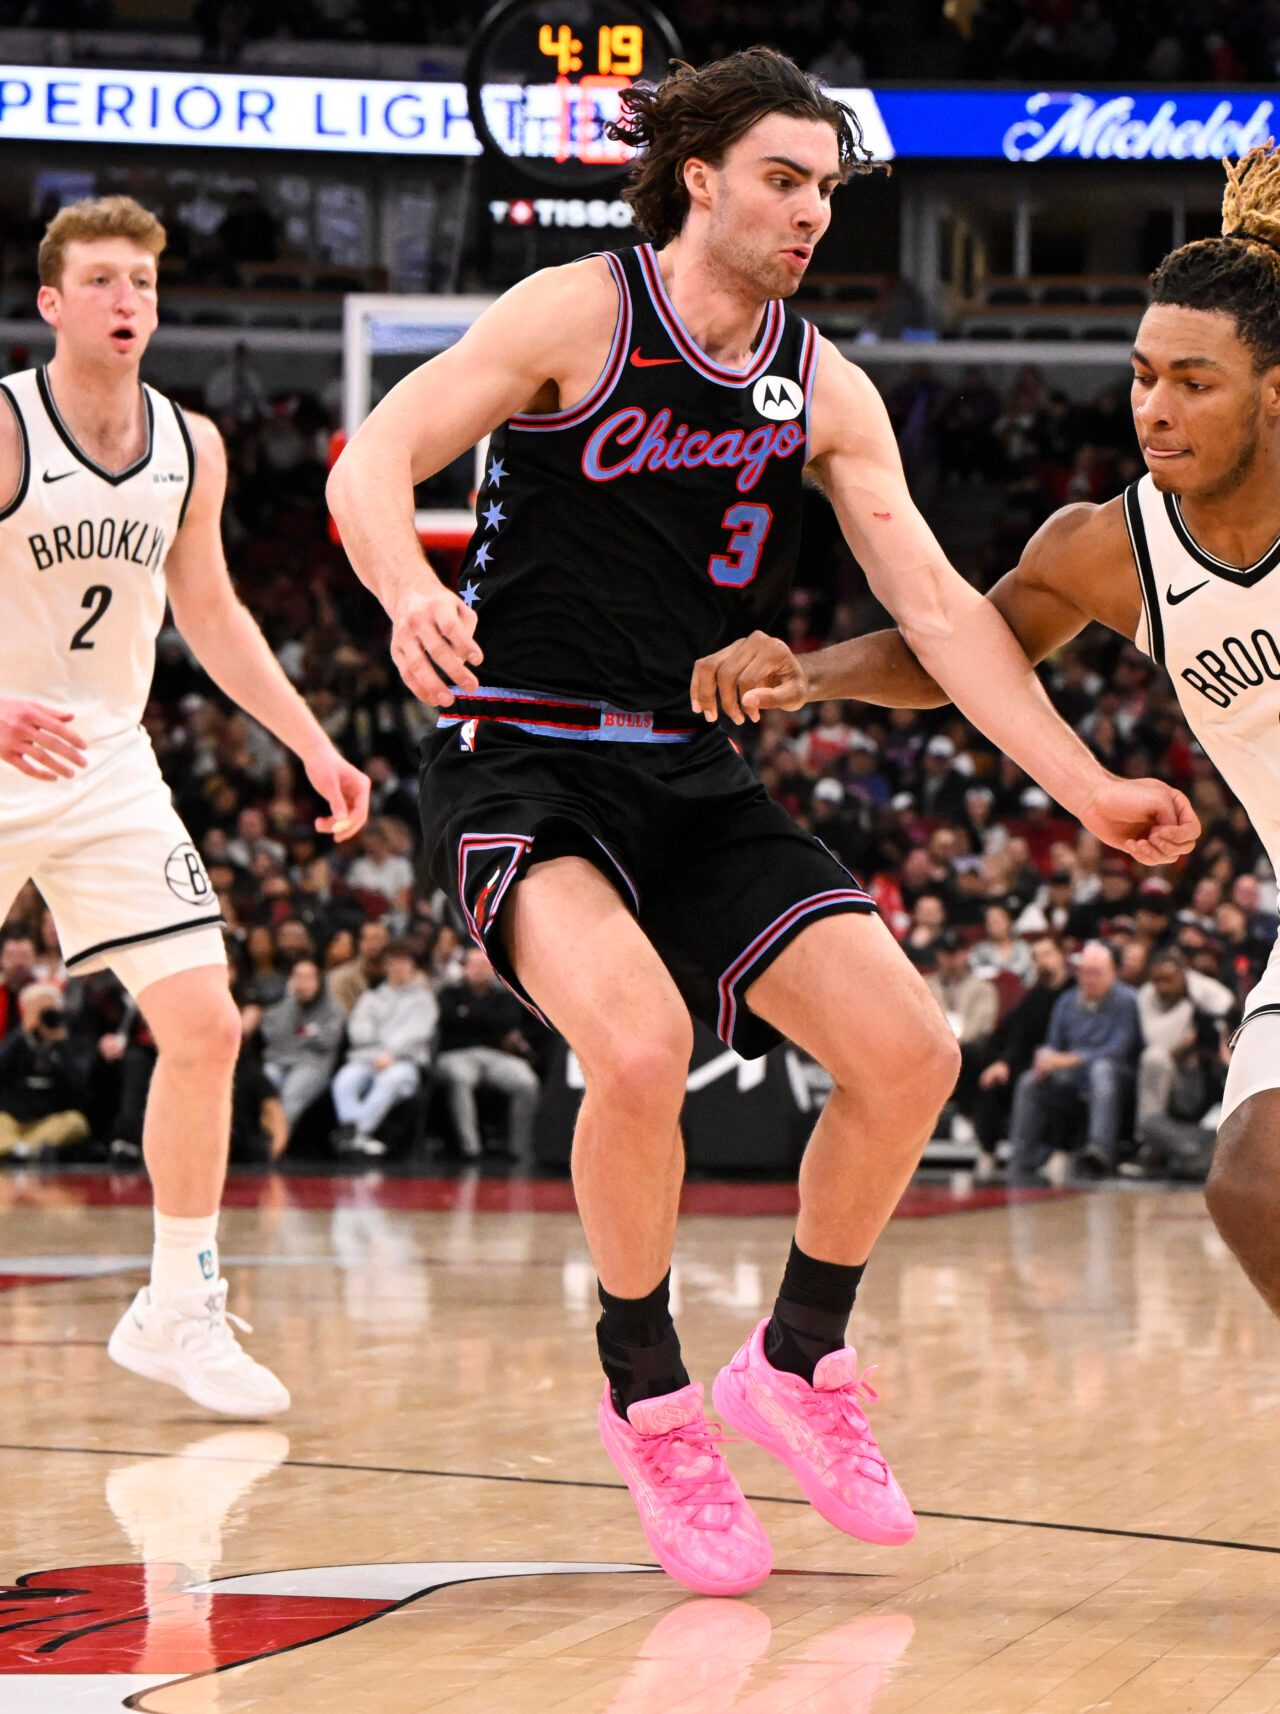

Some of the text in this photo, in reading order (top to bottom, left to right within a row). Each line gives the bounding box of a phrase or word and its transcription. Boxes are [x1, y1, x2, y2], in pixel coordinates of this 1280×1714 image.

[538, 24, 644, 76] 4:19
[0, 80, 274, 134] PERIOR
[1002, 92, 1274, 162] Michelob
[534, 199, 635, 228] TISSO
[581, 406, 806, 493] Chicago
[27, 517, 165, 576] BROOKLYN
[708, 502, 774, 588] 3
[70, 584, 113, 651] 2
[604, 711, 652, 728] BULLS
